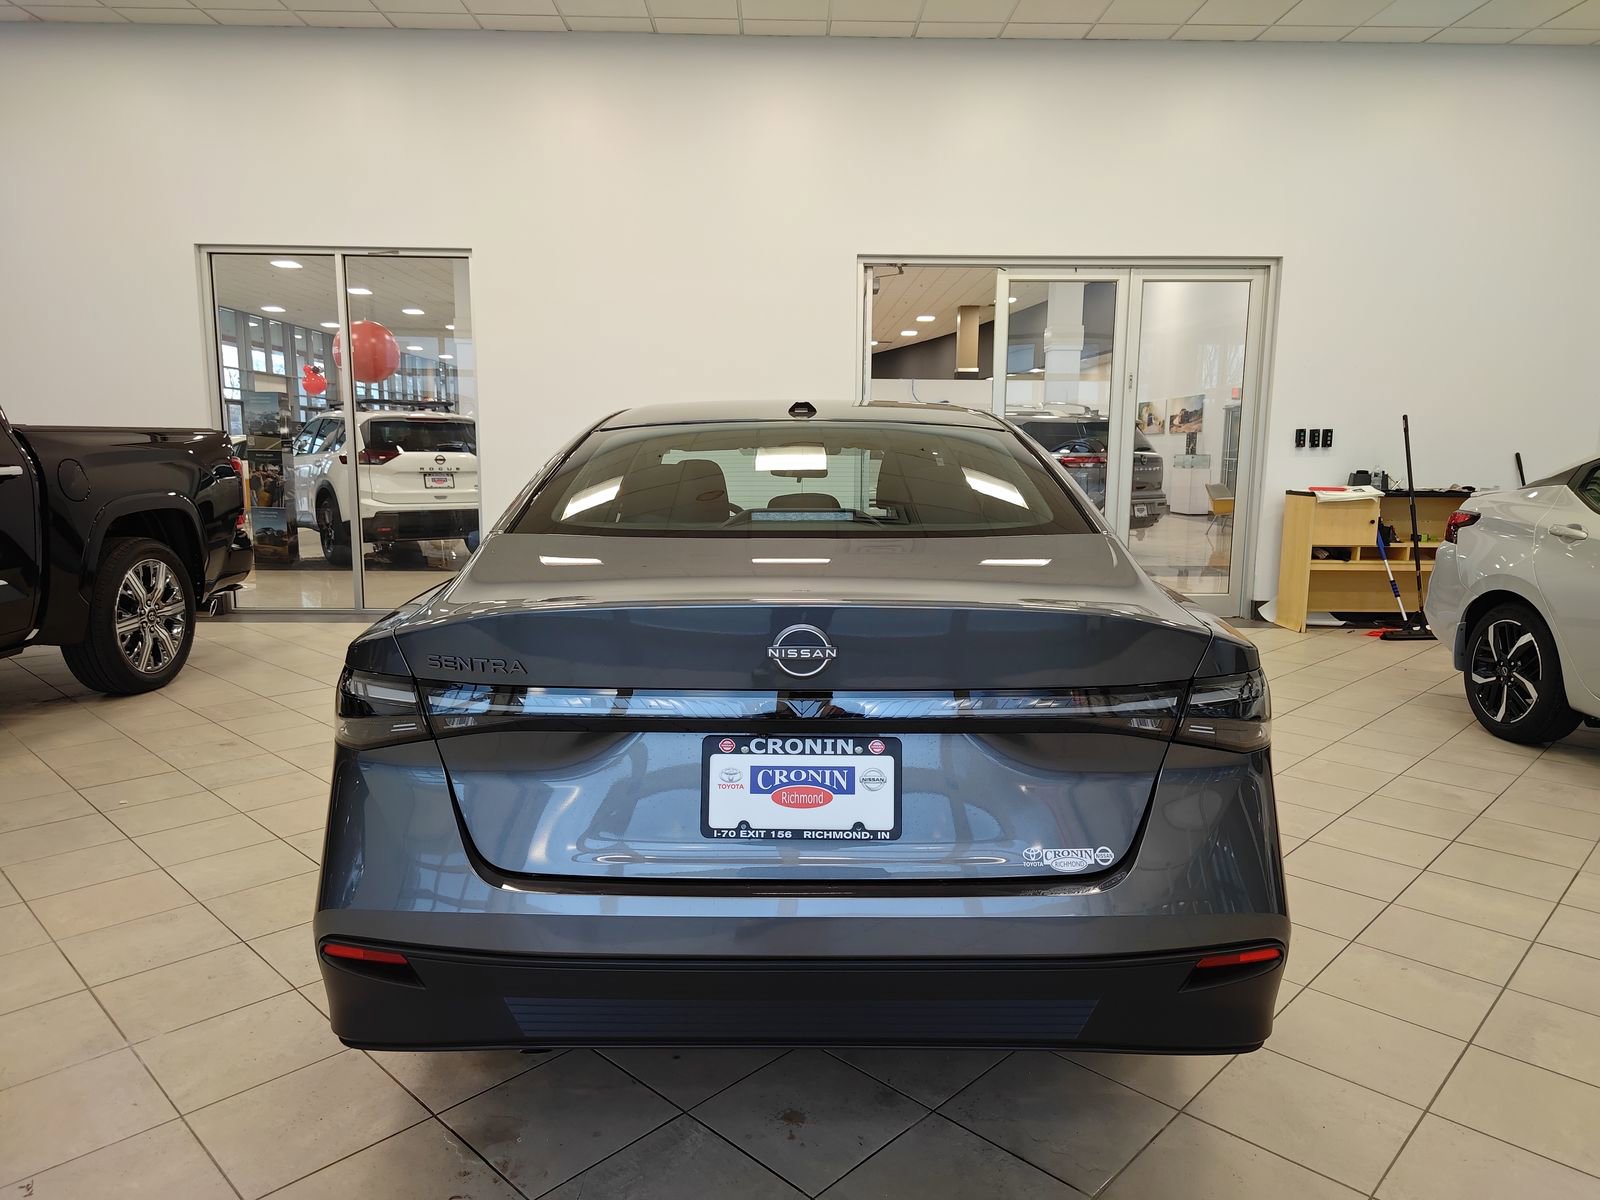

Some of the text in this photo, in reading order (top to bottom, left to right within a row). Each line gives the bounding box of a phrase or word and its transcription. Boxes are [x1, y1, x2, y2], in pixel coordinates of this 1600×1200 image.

[768, 648, 837, 658] NISSAN
[425, 653, 529, 675] SENTRA
[749, 738, 854, 755] CRONIN
[757, 769, 849, 791] CRONIN
[781, 791, 824, 804] Richmond
[713, 829, 890, 840] I-70 EXIT 156 RICHMOND, IN
[1044, 849, 1093, 861] CRONIN
[1055, 860, 1086, 868] RICHMOND
